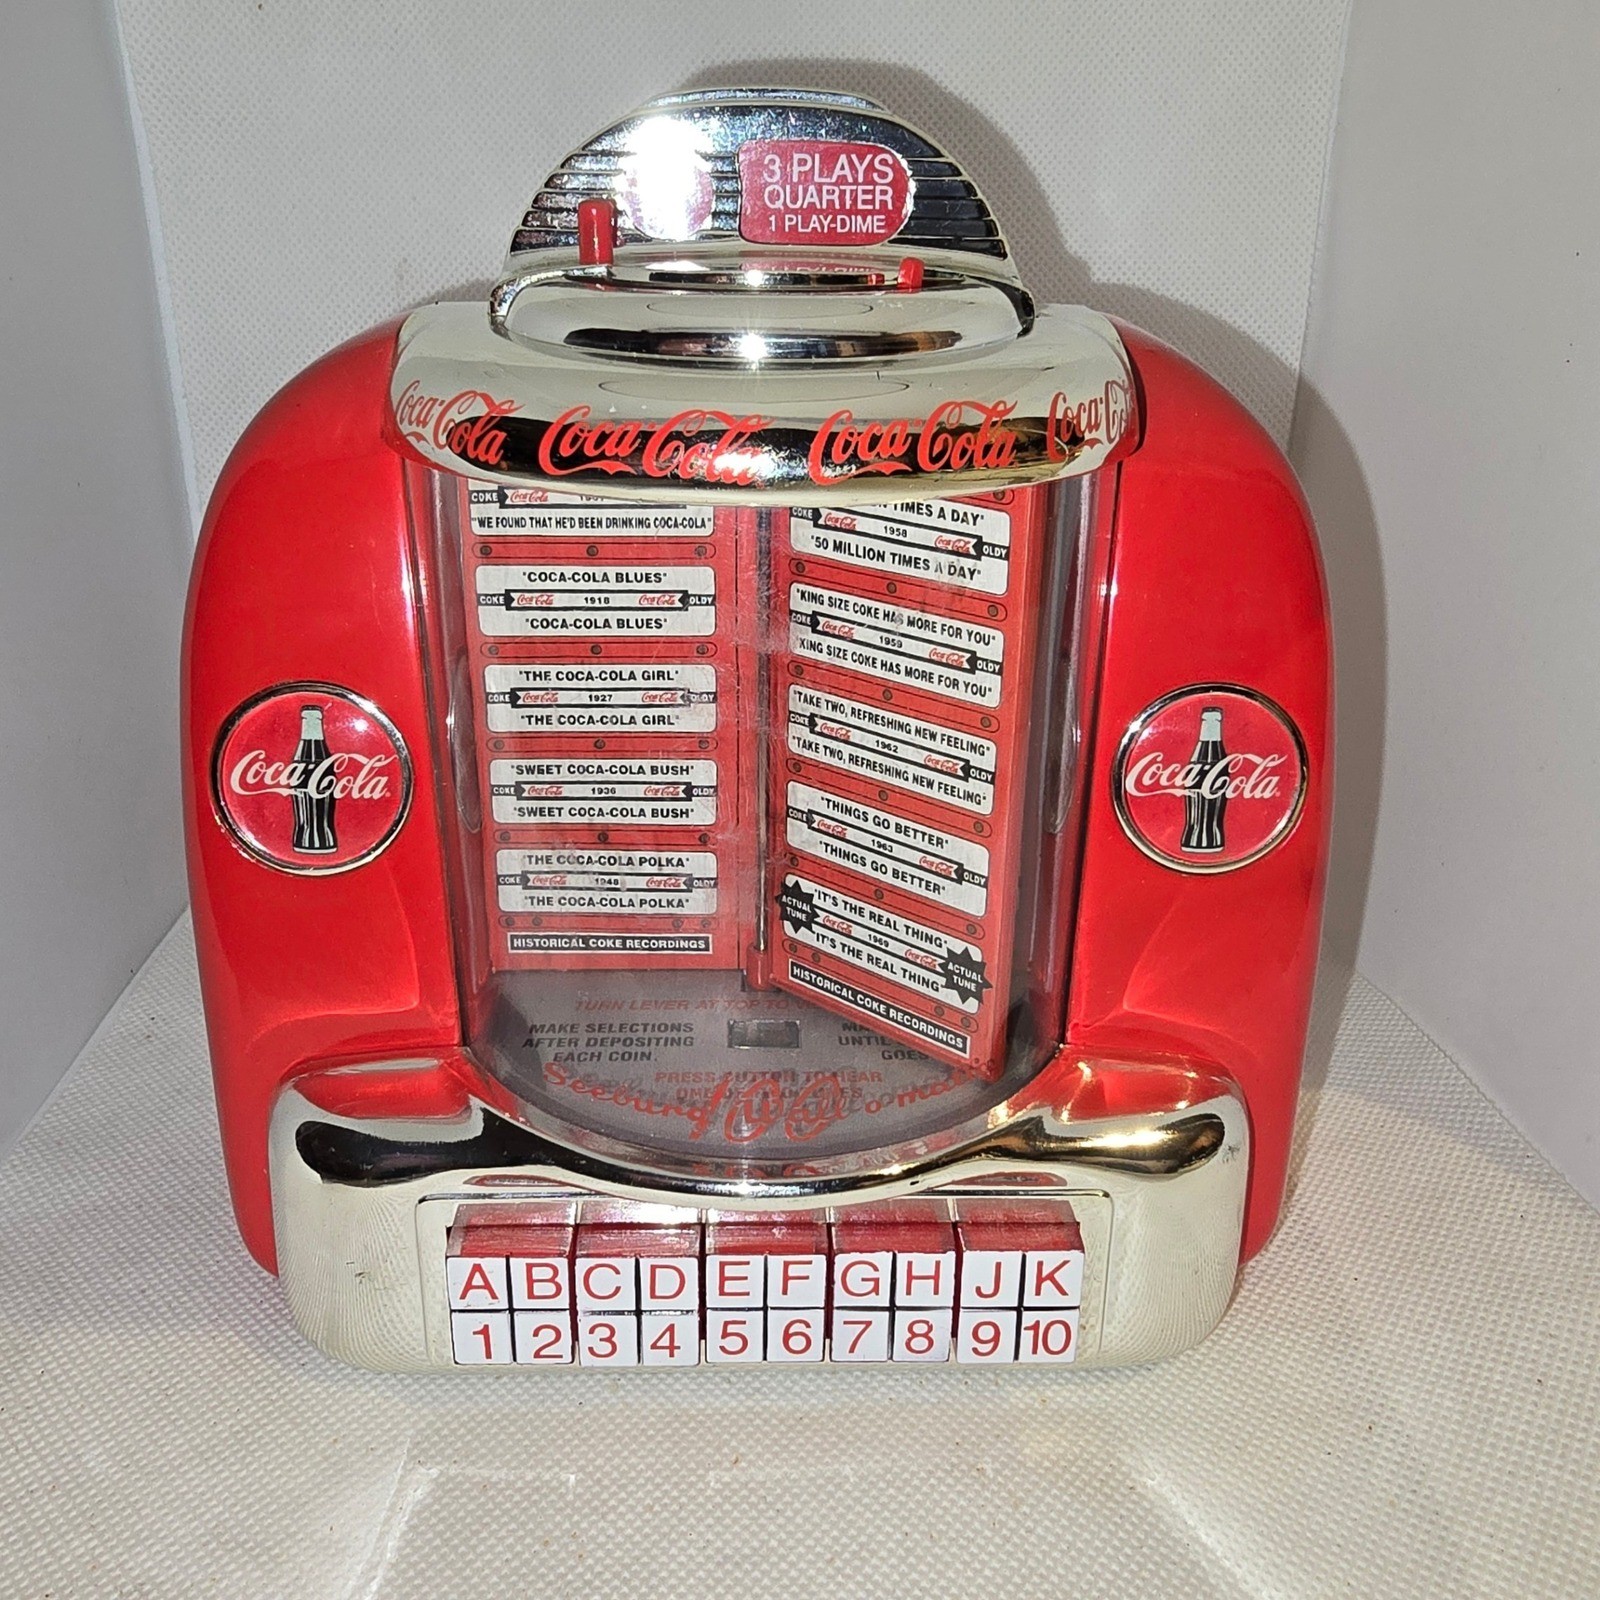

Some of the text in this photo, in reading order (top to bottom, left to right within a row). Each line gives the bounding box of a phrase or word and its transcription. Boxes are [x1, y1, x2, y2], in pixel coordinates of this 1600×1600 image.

[764, 153, 894, 184] 3 PLAYS
[764, 184, 893, 210] QUARTER
[769, 215, 886, 233] 1 PLAY-DIME
[396, 380, 525, 465] Coca-Cola
[807, 400, 1018, 485] Coca-Cola
[471, 492, 498, 502] COKE
[893, 502, 933, 517] TIMES
[937, 507, 947, 520] A
[495, 517, 527, 529] FOUND
[529, 517, 553, 529] THAT
[555, 517, 576, 529] HE'D
[579, 517, 603, 529] BEEN
[606, 517, 651, 529] DRINKING
[792, 507, 1008, 559] COKE 1958 OLDY
[833, 539, 885, 563] MILLION
[890, 552, 931, 570] TIMES
[480, 595, 712, 605] COKE 1918 OLDY
[828, 595, 850, 612] SIZE
[853, 601, 880, 619] COKE
[883, 609, 904, 625] HAS
[906, 615, 937, 634] MORE
[941, 624, 962, 640] FOR
[791, 614, 1000, 673] COKE 1959 OLDY
[555, 670, 637, 682] COCA-COLA
[826, 645, 848, 661] SIZE
[851, 651, 878, 668] COKE
[880, 659, 901, 674] HAS
[904, 666, 935, 684] MORE
[938, 675, 959, 691] FOR
[488, 694, 511, 703] COKE
[588, 694, 613, 702] 1927
[557, 715, 637, 726] COCA-COLA
[825, 699, 849, 717] TWO,
[851, 706, 912, 735] REFRESHING
[914, 727, 938, 743] NEW
[789, 714, 992, 782] COKE 1962 OLDY
[230, 750, 399, 800] Coca-Cola
[567, 764, 646, 776] COCA-COLA
[823, 745, 846, 763] TWO,
[848, 753, 909, 782] REFRESHING
[912, 774, 934, 791] NEW
[1125, 752, 1288, 799] Coca-Cola
[493, 787, 715, 796] COKE 1936 OLDY
[568, 807, 647, 818] COCA-COLA
[873, 814, 891, 830] GO
[788, 808, 985, 886] COKE 1963 OLDY
[556, 855, 635, 866] COCA-COLA
[871, 860, 888, 876] GO
[500, 877, 521, 885] COKE
[693, 879, 715, 888] OLDY
[558, 896, 635, 907] COCA-COLA
[781, 895, 811, 913] ACTUAL
[785, 907, 807, 921] TUNE
[842, 901, 865, 918] THE
[869, 909, 900, 932] REAL
[513, 937, 706, 949] HISTORICAL COKE RECORDINGS
[867, 934, 890, 949] 1969
[840, 944, 863, 961] THE
[866, 952, 897, 975] REAL
[947, 962, 983, 982] ACTUAL
[952, 975, 977, 992] TUNE
[575, 1000, 689, 1011] TURN LEVER
[793, 965, 964, 1050] HISTORICAL COKE RECORDINGS
[529, 1022, 694, 1034] MAKE SELECTIONS
[522, 1036, 694, 1048] AFTER DEPOSITING
[838, 1035, 891, 1046] UNTIL
[553, 1051, 601, 1062] EACH
[654, 1072, 716, 1083] PRESS
[459, 1260, 1071, 1300] A B C D E F G H J K
[472, 1319, 1072, 1359] 1 2 3 4 5 6 7 8 9 10
